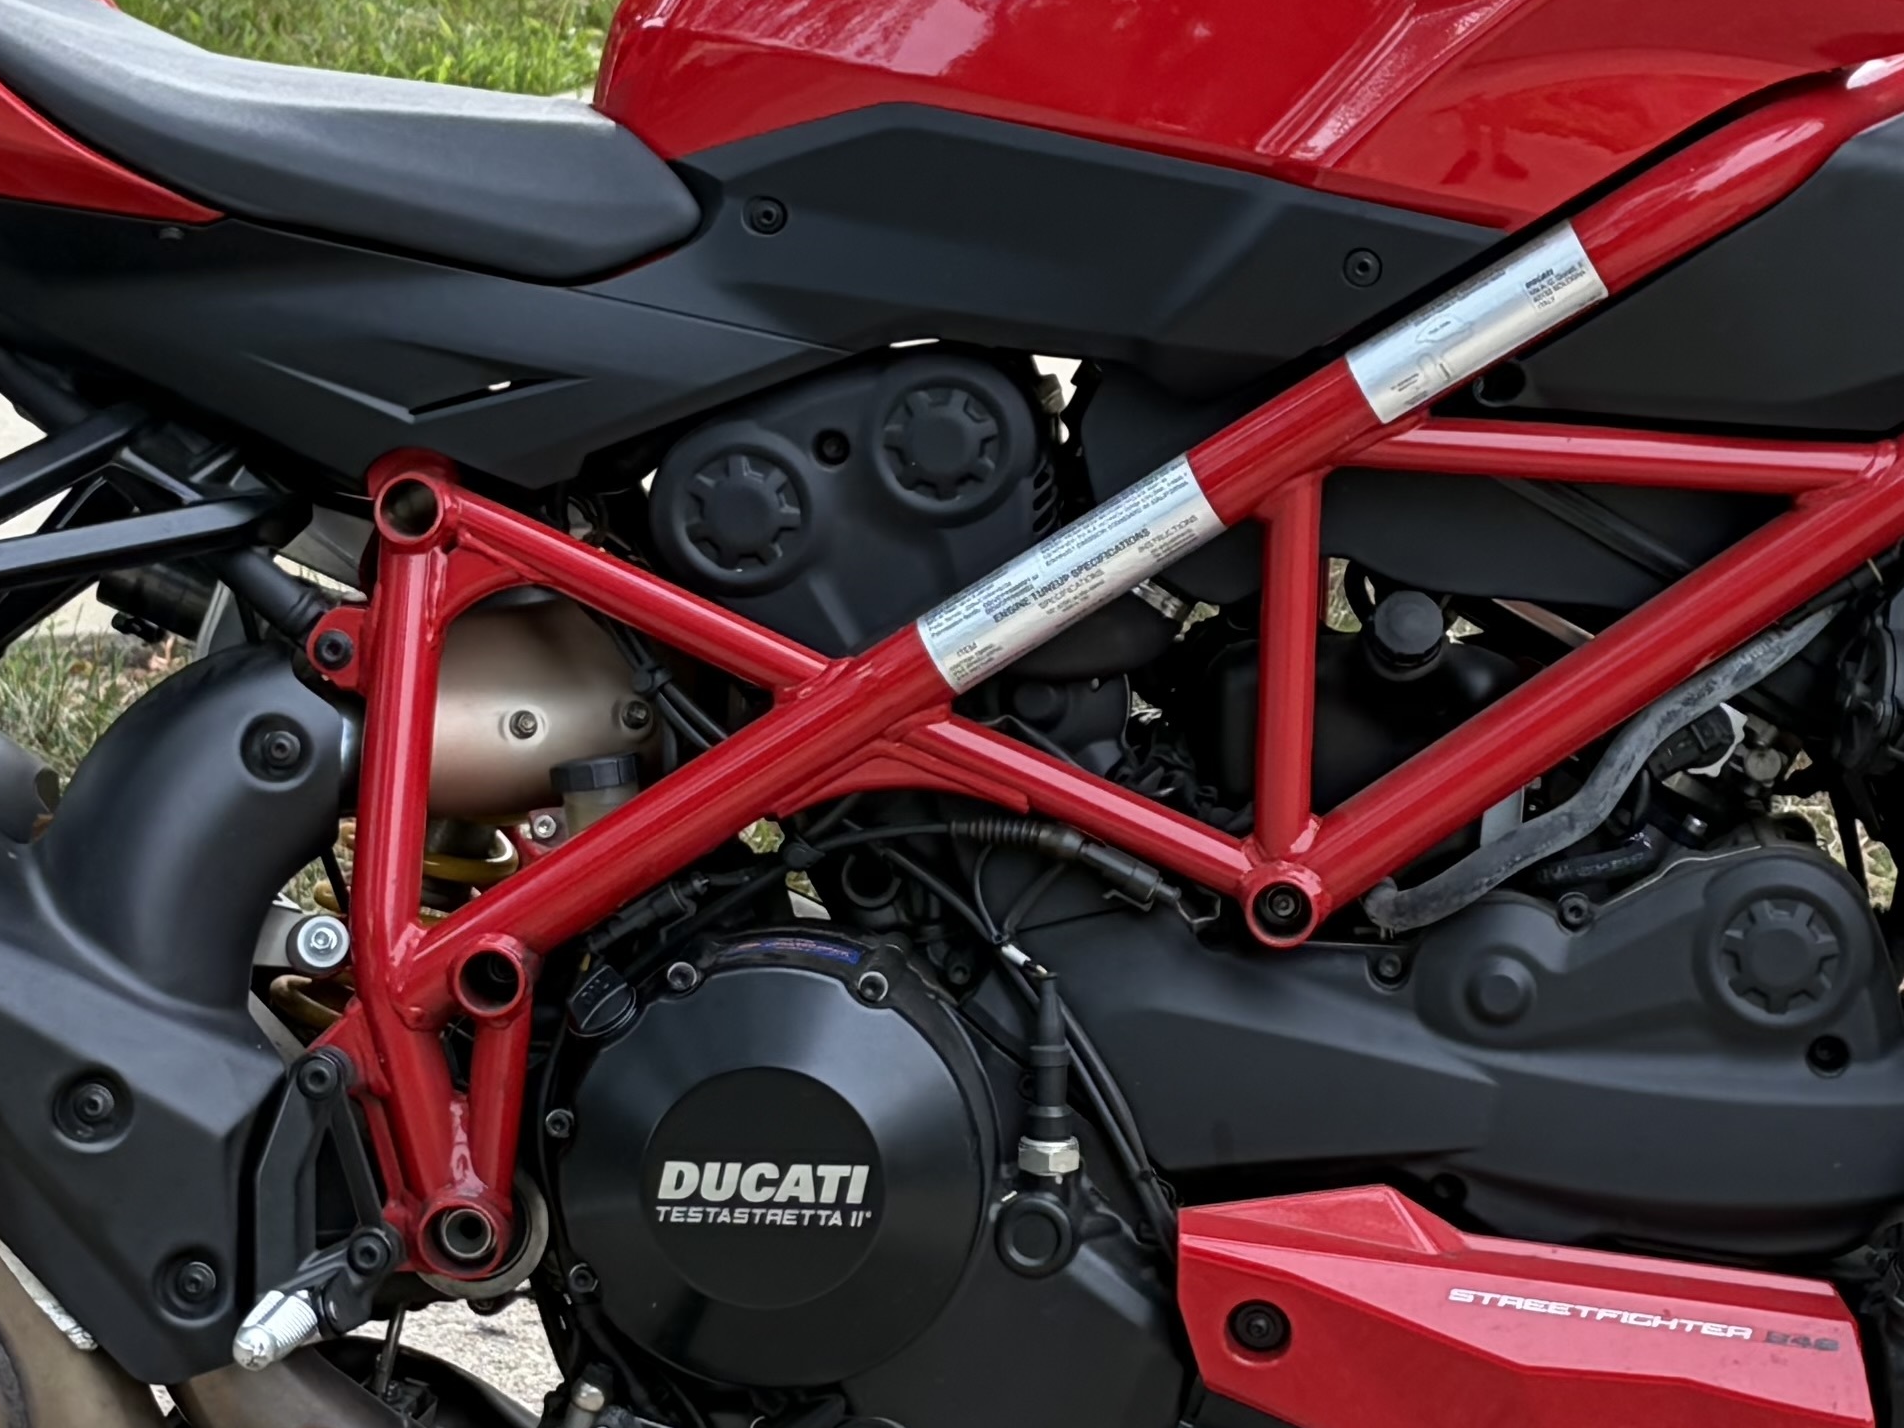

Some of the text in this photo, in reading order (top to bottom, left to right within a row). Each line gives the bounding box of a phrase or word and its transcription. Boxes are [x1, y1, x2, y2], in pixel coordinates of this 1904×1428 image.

[991, 595, 1031, 623] ENGINE
[1069, 526, 1151, 578] SPECIFICATIONS
[657, 1160, 870, 1204] DUCATI
[656, 1205, 843, 1227] TESTASTRETTA
[1447, 1287, 1753, 1341] STREETFIGHTER
